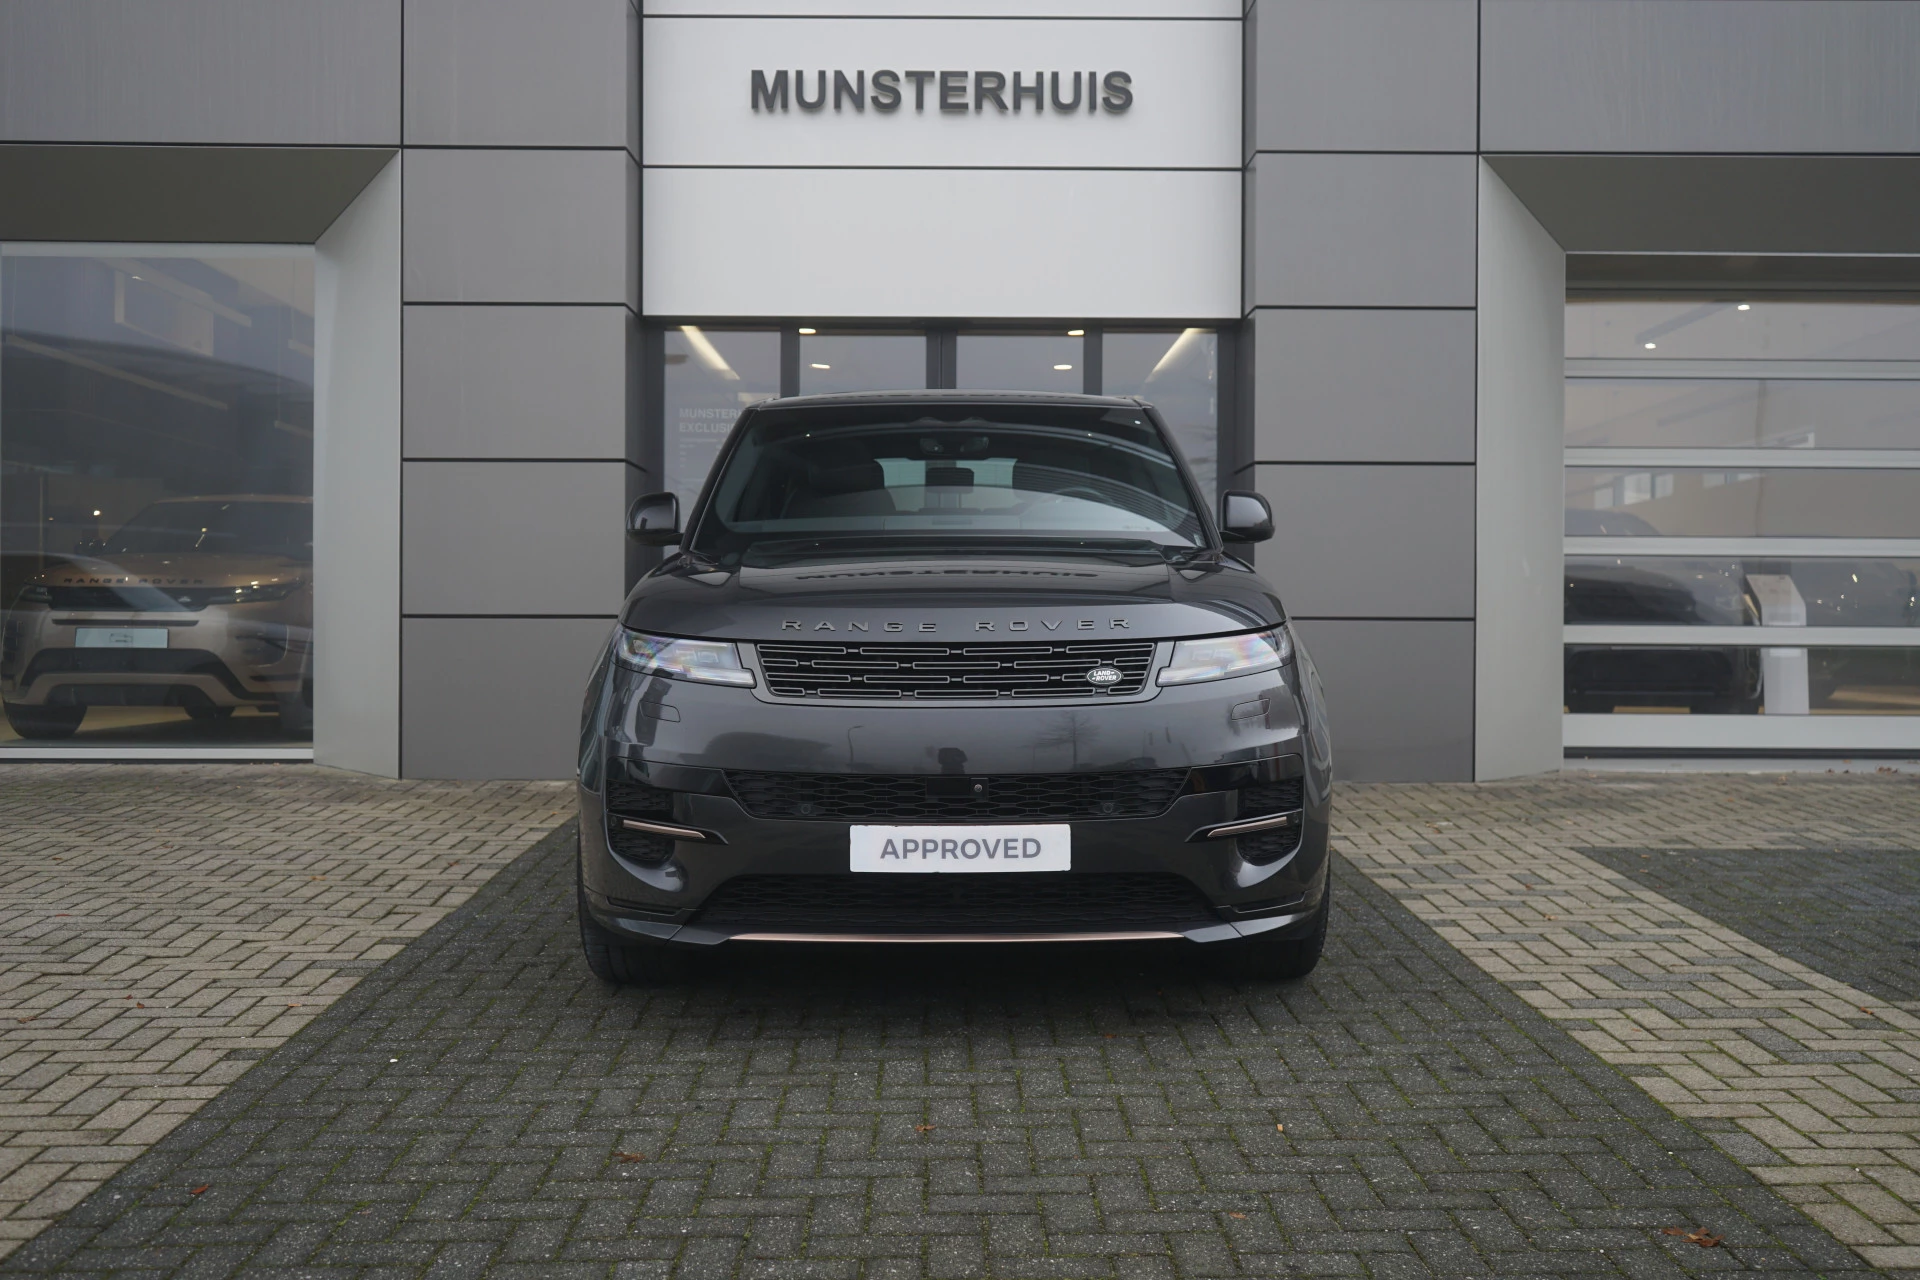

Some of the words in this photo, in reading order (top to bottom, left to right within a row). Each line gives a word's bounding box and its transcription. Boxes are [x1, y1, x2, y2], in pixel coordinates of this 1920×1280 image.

[750, 69, 1133, 113] MUNSTERHUIS
[138, 577, 204, 585] ROVER
[781, 619, 937, 633] RANGE
[975, 617, 1131, 632] ROVER
[880, 838, 1042, 860] APPROVED
